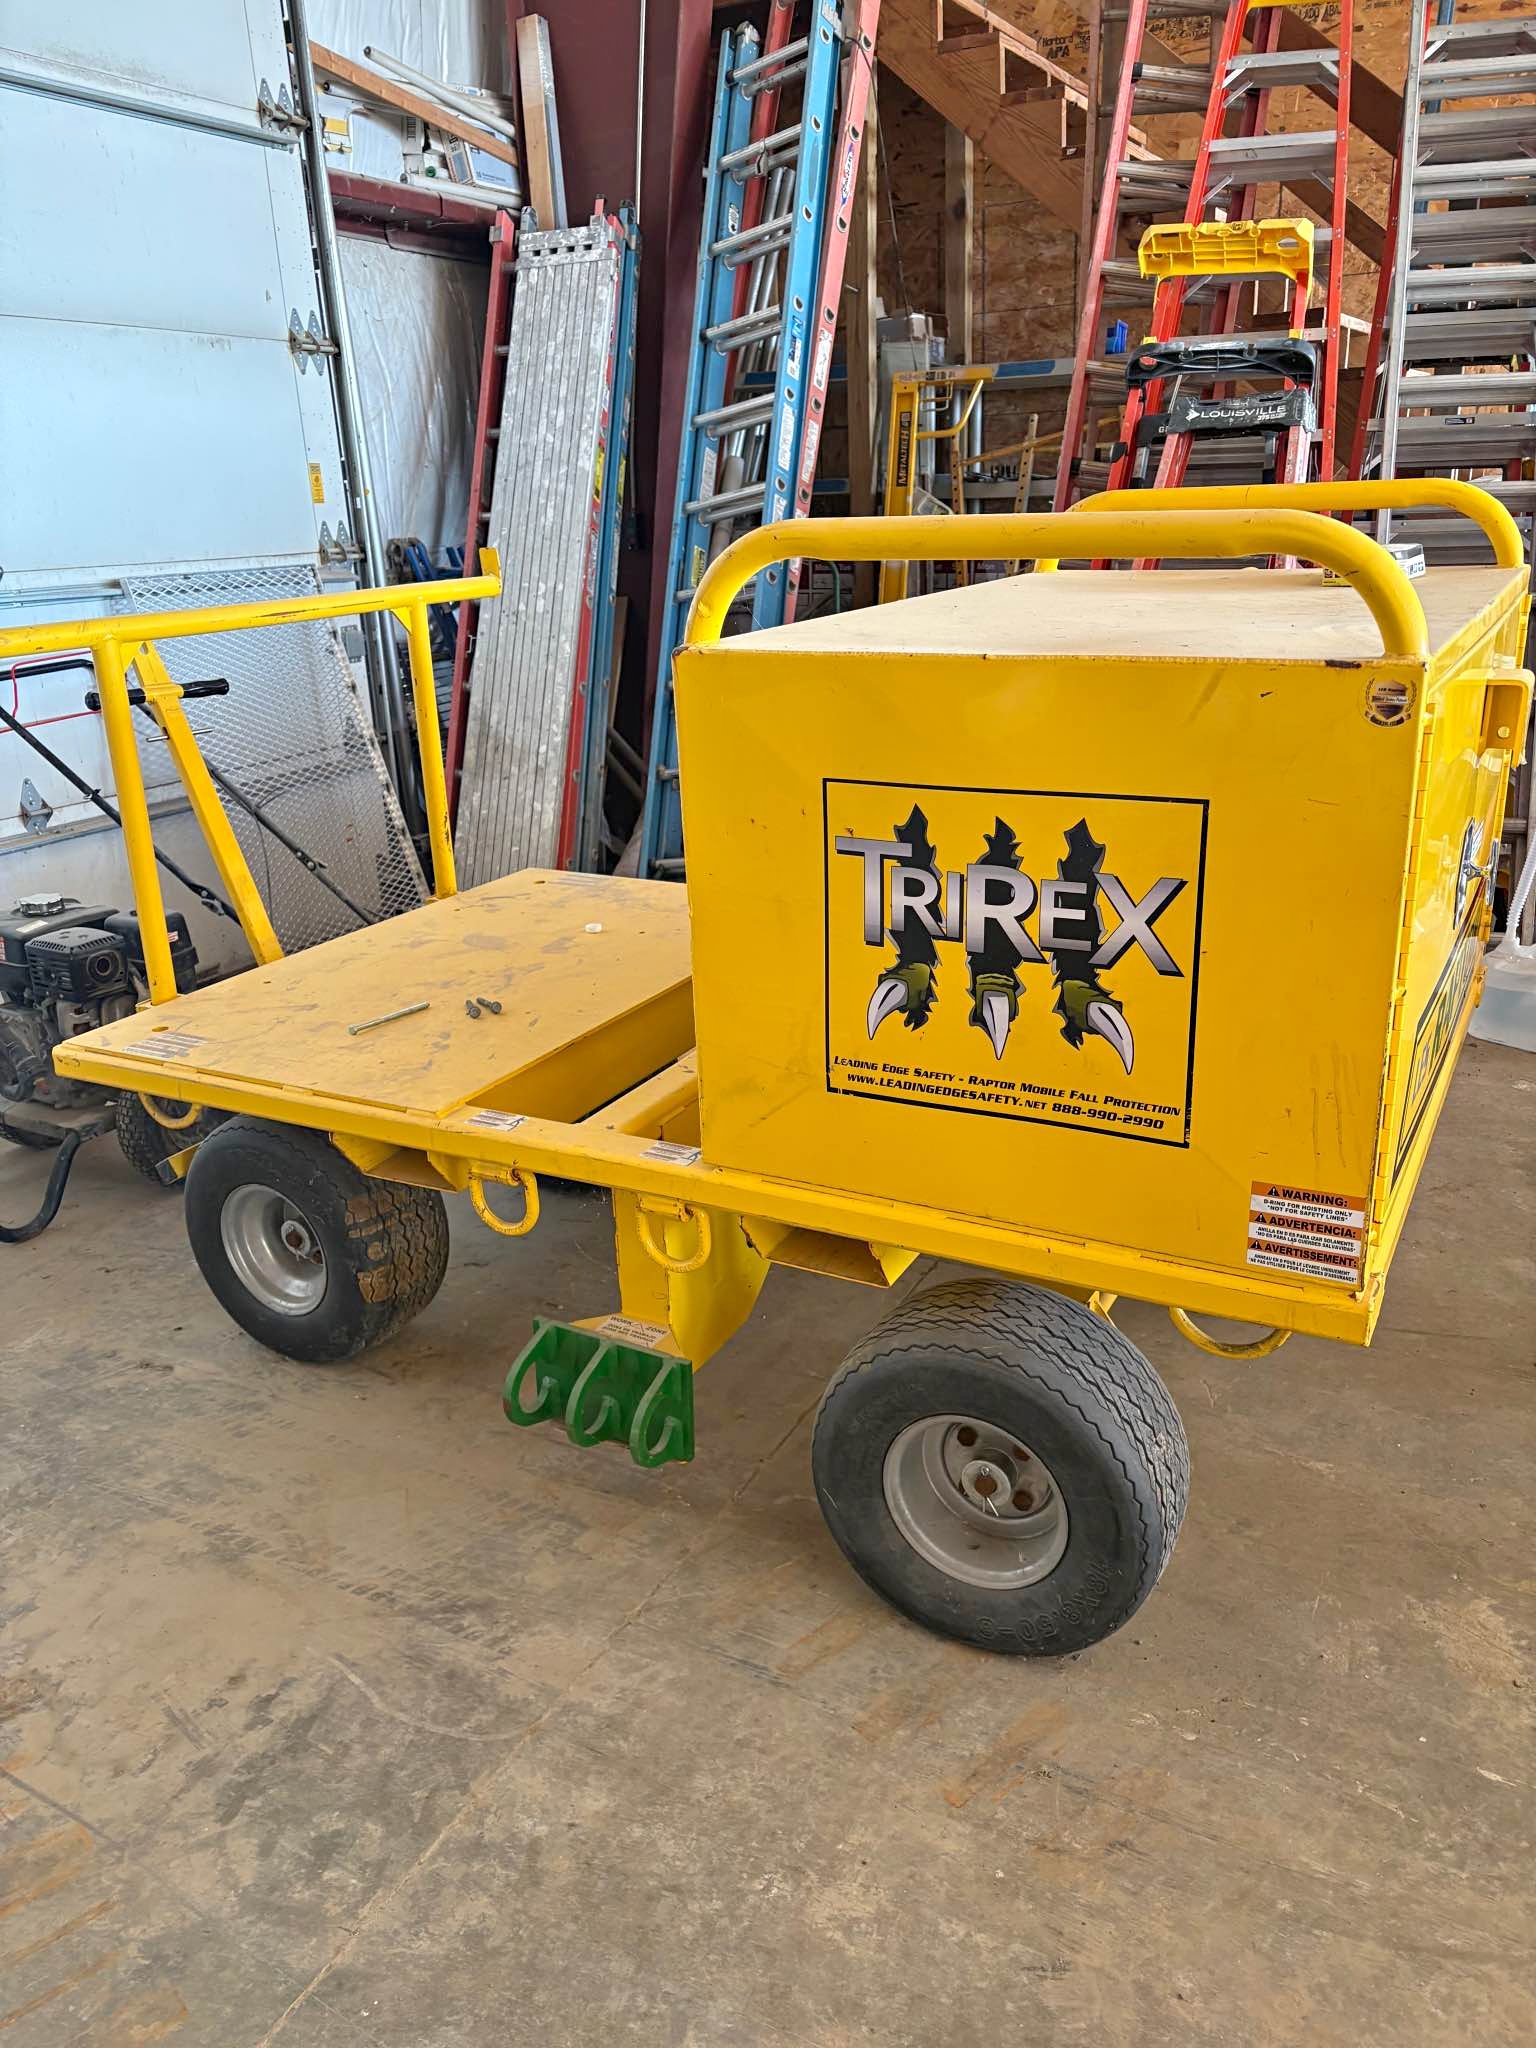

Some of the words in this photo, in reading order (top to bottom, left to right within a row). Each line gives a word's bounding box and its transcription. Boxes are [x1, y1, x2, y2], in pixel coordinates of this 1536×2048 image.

[1047, 45, 1070, 58] APA
[1201, 405, 1286, 418] LOUISVILLE
[834, 836, 1189, 978] TRIREX
[834, 1056, 878, 1070] LEADING
[882, 1063, 909, 1075] EDGE
[914, 1068, 955, 1081] SAFETY
[968, 1075, 1015, 1091] RAPTOR
[1020, 1083, 1065, 1098] MOBILE
[1070, 1090, 1098, 1103] FALL
[1104, 1096, 1180, 1116] PROTECTION
[1052, 1103, 1164, 1129] 888-990-2990
[1264, 1199, 1285, 1207] D-RING
[1302, 1204, 1333, 1214] HOISTING
[1282, 1189, 1348, 1207] WARNING:
[1285, 1208, 1298, 1216] FOR
[1300, 1210, 1324, 1219] SAFETY
[1269, 1216, 1356, 1238] ADVERTENCIA:
[1265, 1243, 1357, 1267] AVERTISSEMENT:
